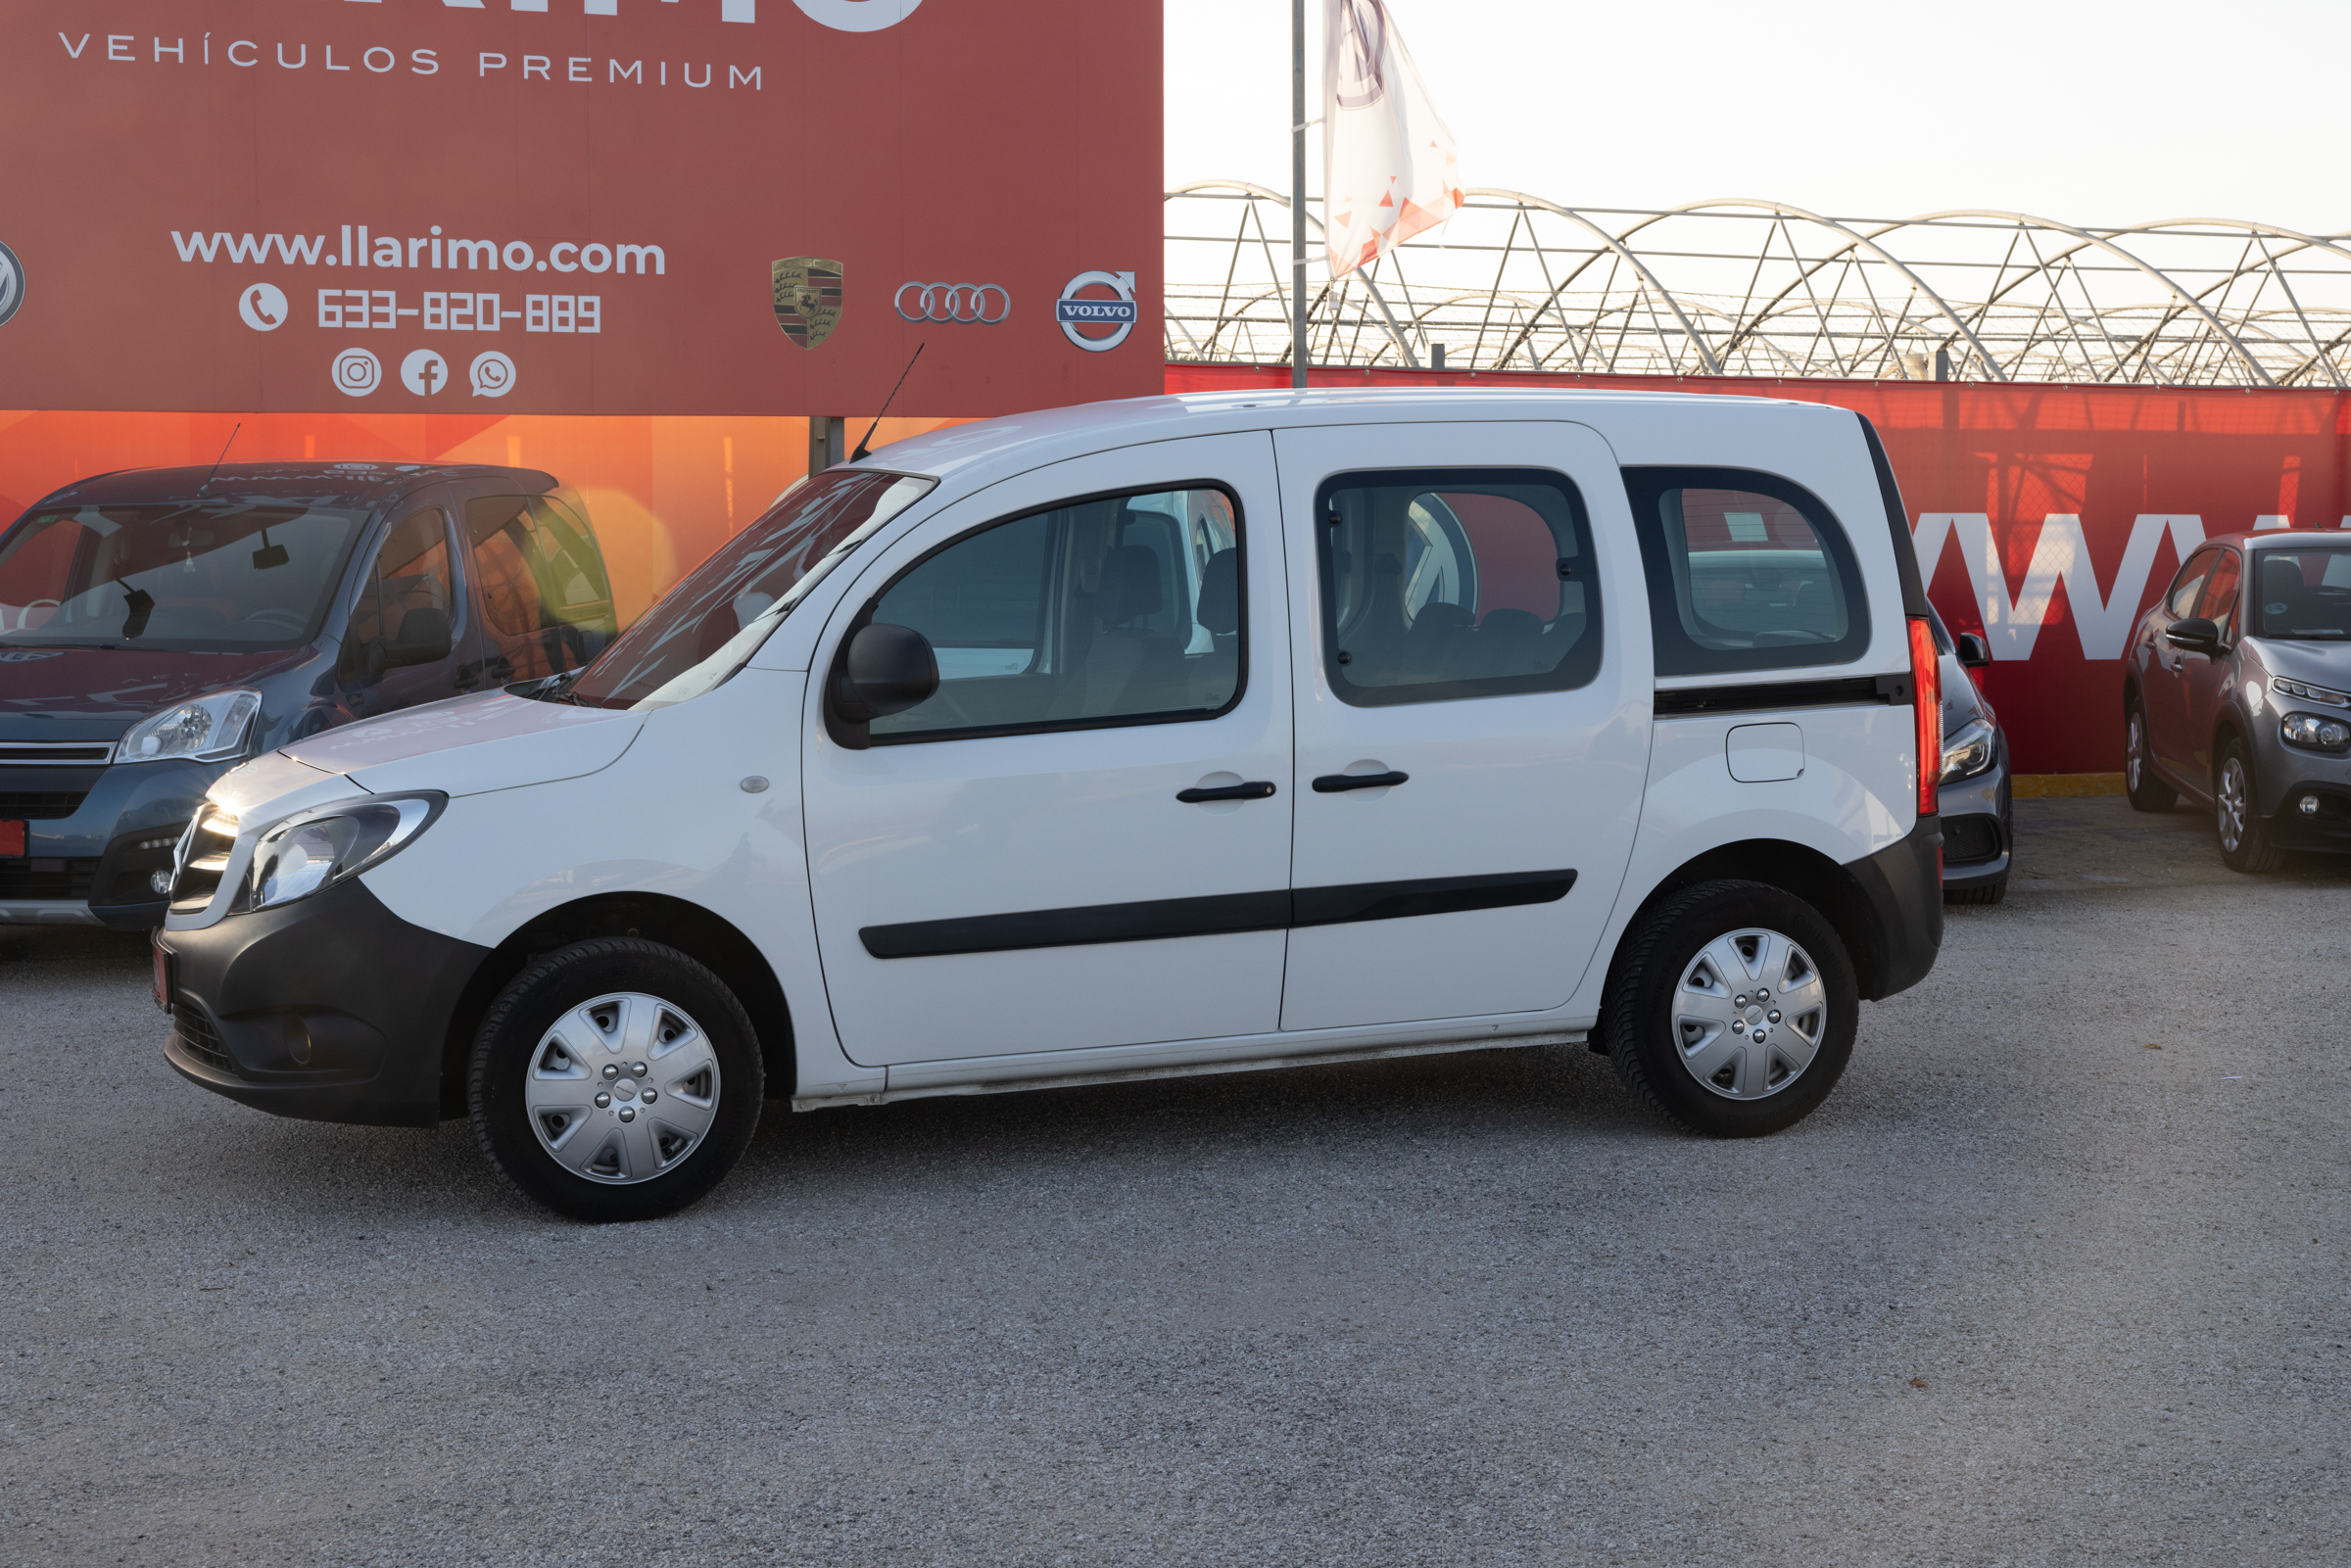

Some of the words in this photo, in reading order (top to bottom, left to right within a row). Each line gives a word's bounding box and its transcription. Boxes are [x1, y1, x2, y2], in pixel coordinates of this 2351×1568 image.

[58, 31, 440, 75] VEHÍCULOS
[478, 52, 763, 90] PREMIUM
[170, 224, 665, 275] www.llarimo.com
[317, 288, 601, 334] 633-820-889
[1062, 305, 1131, 317] VOLVO
